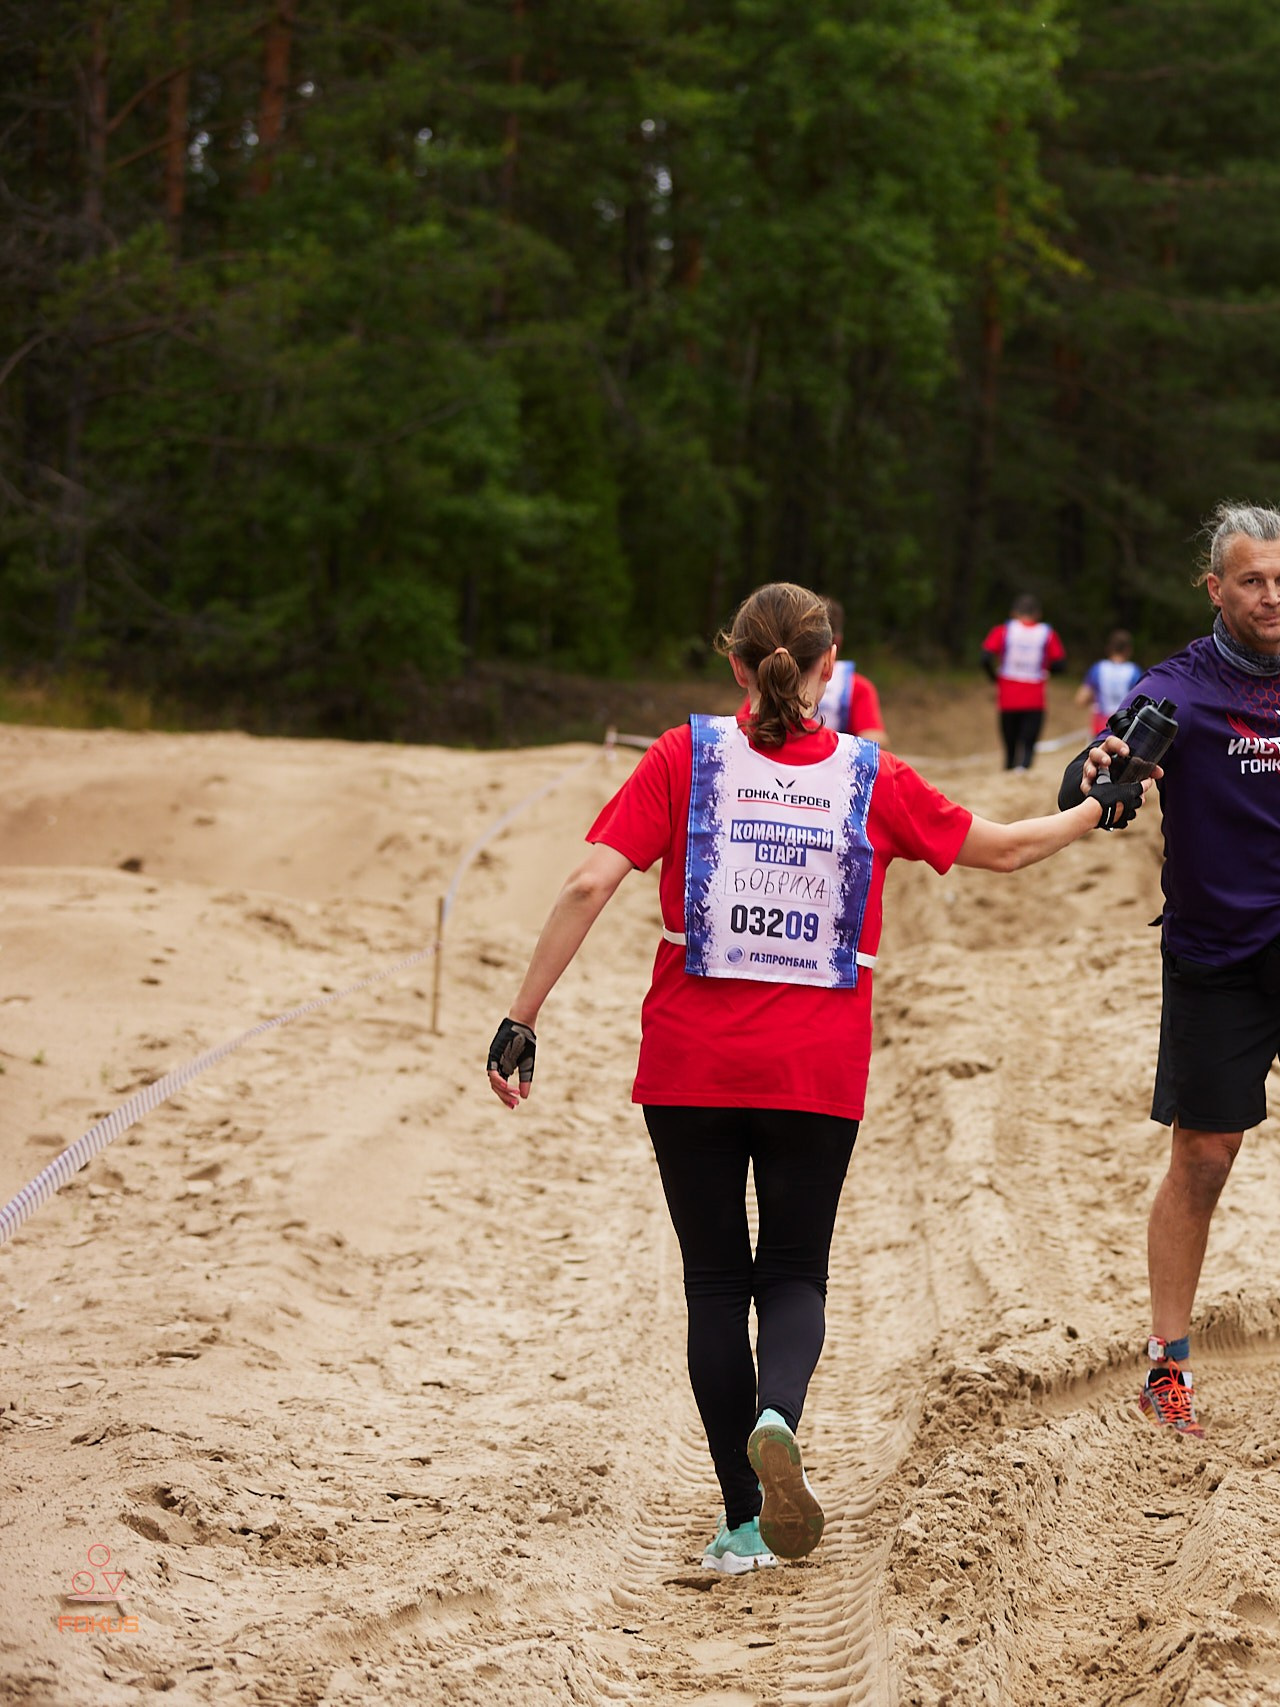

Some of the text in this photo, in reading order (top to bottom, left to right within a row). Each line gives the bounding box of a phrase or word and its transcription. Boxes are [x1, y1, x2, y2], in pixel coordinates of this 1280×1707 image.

[737, 788, 831, 809] ГОНКА ГЕРОЕВ
[733, 821, 832, 849] КОМАНДНЫЙ
[758, 843, 804, 865] СТАРТ
[734, 868, 828, 900] БОБРИХА
[730, 904, 820, 942] 03209
[750, 952, 818, 970] ГАЗПРОМБАНК
